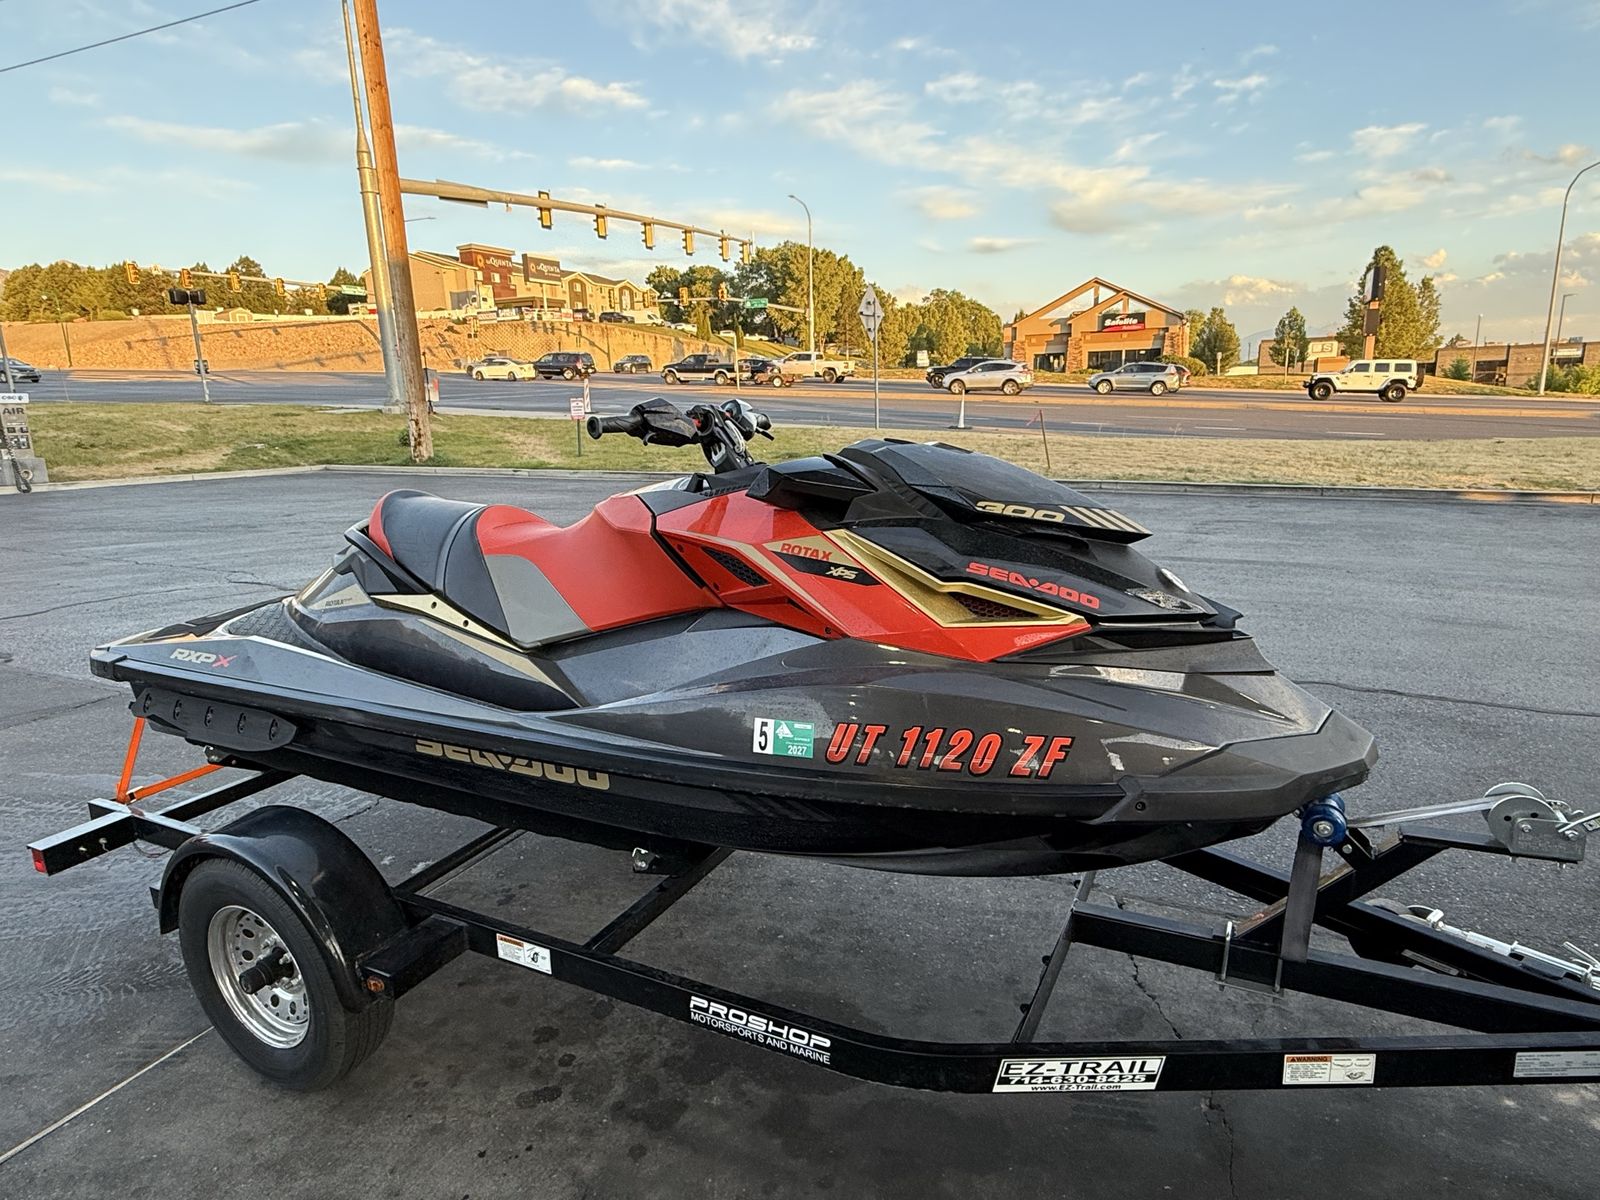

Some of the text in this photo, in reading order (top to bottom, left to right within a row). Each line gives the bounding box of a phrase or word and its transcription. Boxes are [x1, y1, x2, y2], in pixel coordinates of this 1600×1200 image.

[2, 407, 25, 415] AIR
[976, 501, 1065, 523] 300
[780, 542, 833, 561] ROTAX
[825, 566, 859, 580] XPS
[758, 721, 768, 751] 5
[787, 745, 807, 756] 2027
[825, 722, 1076, 779] UT 1120 ZF
[690, 995, 831, 1048] PROSHOP
[691, 1011, 831, 1065] MOTORSPORTS AND MARINE
[1003, 1060, 1156, 1076] EZ-TRAIL
[1009, 1074, 1146, 1085] 714-630-8425
[1031, 1083, 1122, 1091] www.EZ-Trail.com
